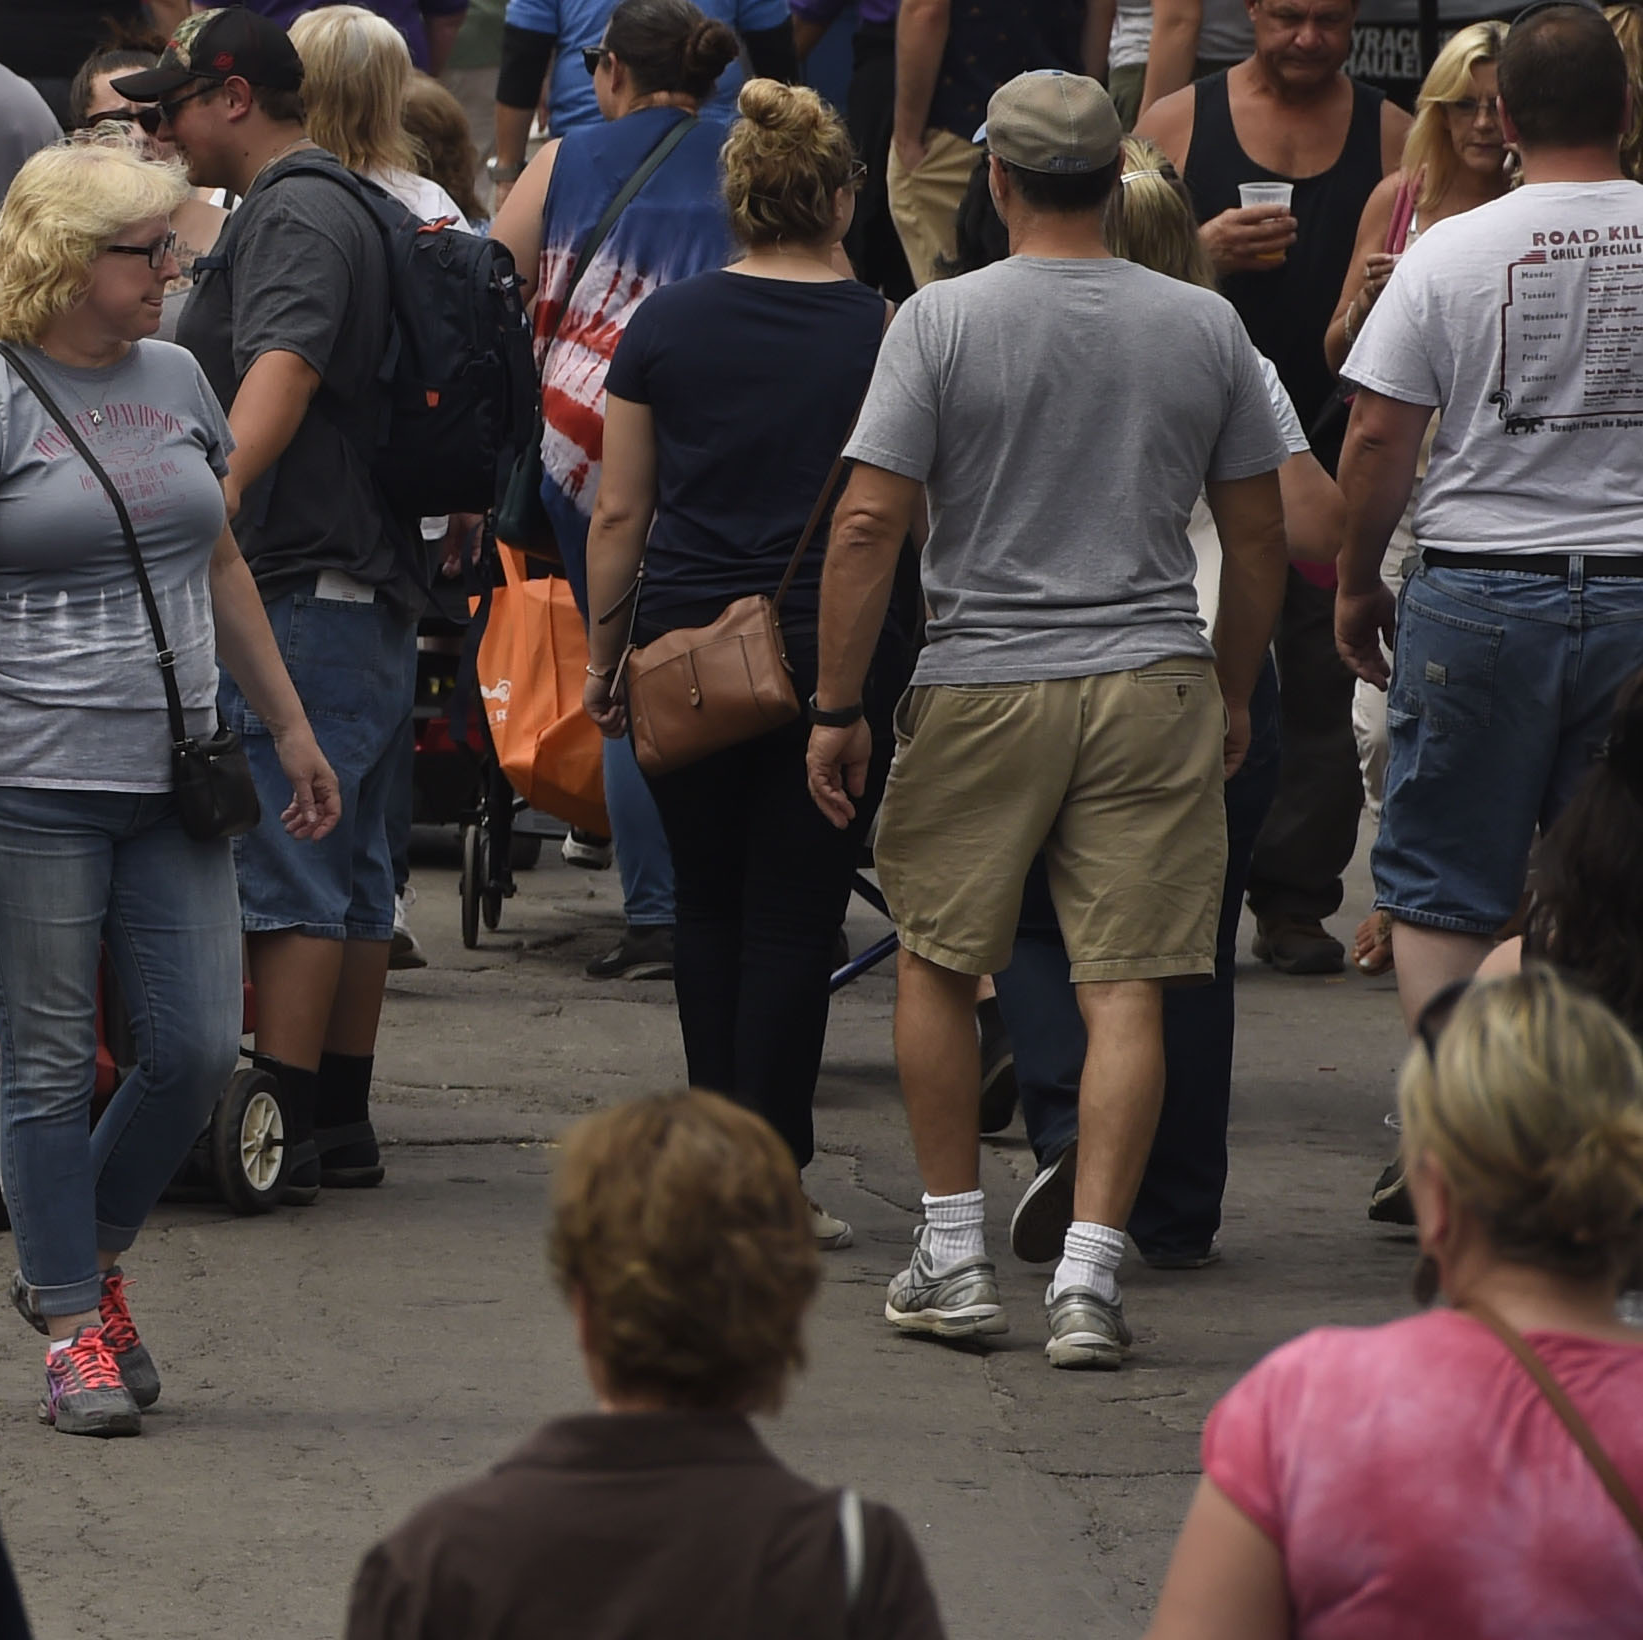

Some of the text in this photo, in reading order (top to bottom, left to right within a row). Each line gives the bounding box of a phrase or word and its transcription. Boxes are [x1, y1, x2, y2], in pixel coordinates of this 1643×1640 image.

[1341, 50, 1422, 78] HAULE
[1532, 227, 1600, 247] ROAD
[1550, 243, 1643, 261] GRILL SPECIALS
[1521, 271, 1553, 280] Monday
[1521, 291, 1556, 301] Tuesday
[1522, 312, 1569, 322] Wednesday
[1522, 332, 1562, 342] Thursday
[1522, 353, 1549, 363] Friday
[1521, 373, 1557, 384] Saturday
[1521, 394, 1549, 405] Sunday
[33, 403, 184, 460] HAREY-DAVIDSON
[86, 429, 165, 447] TORCYCLES
